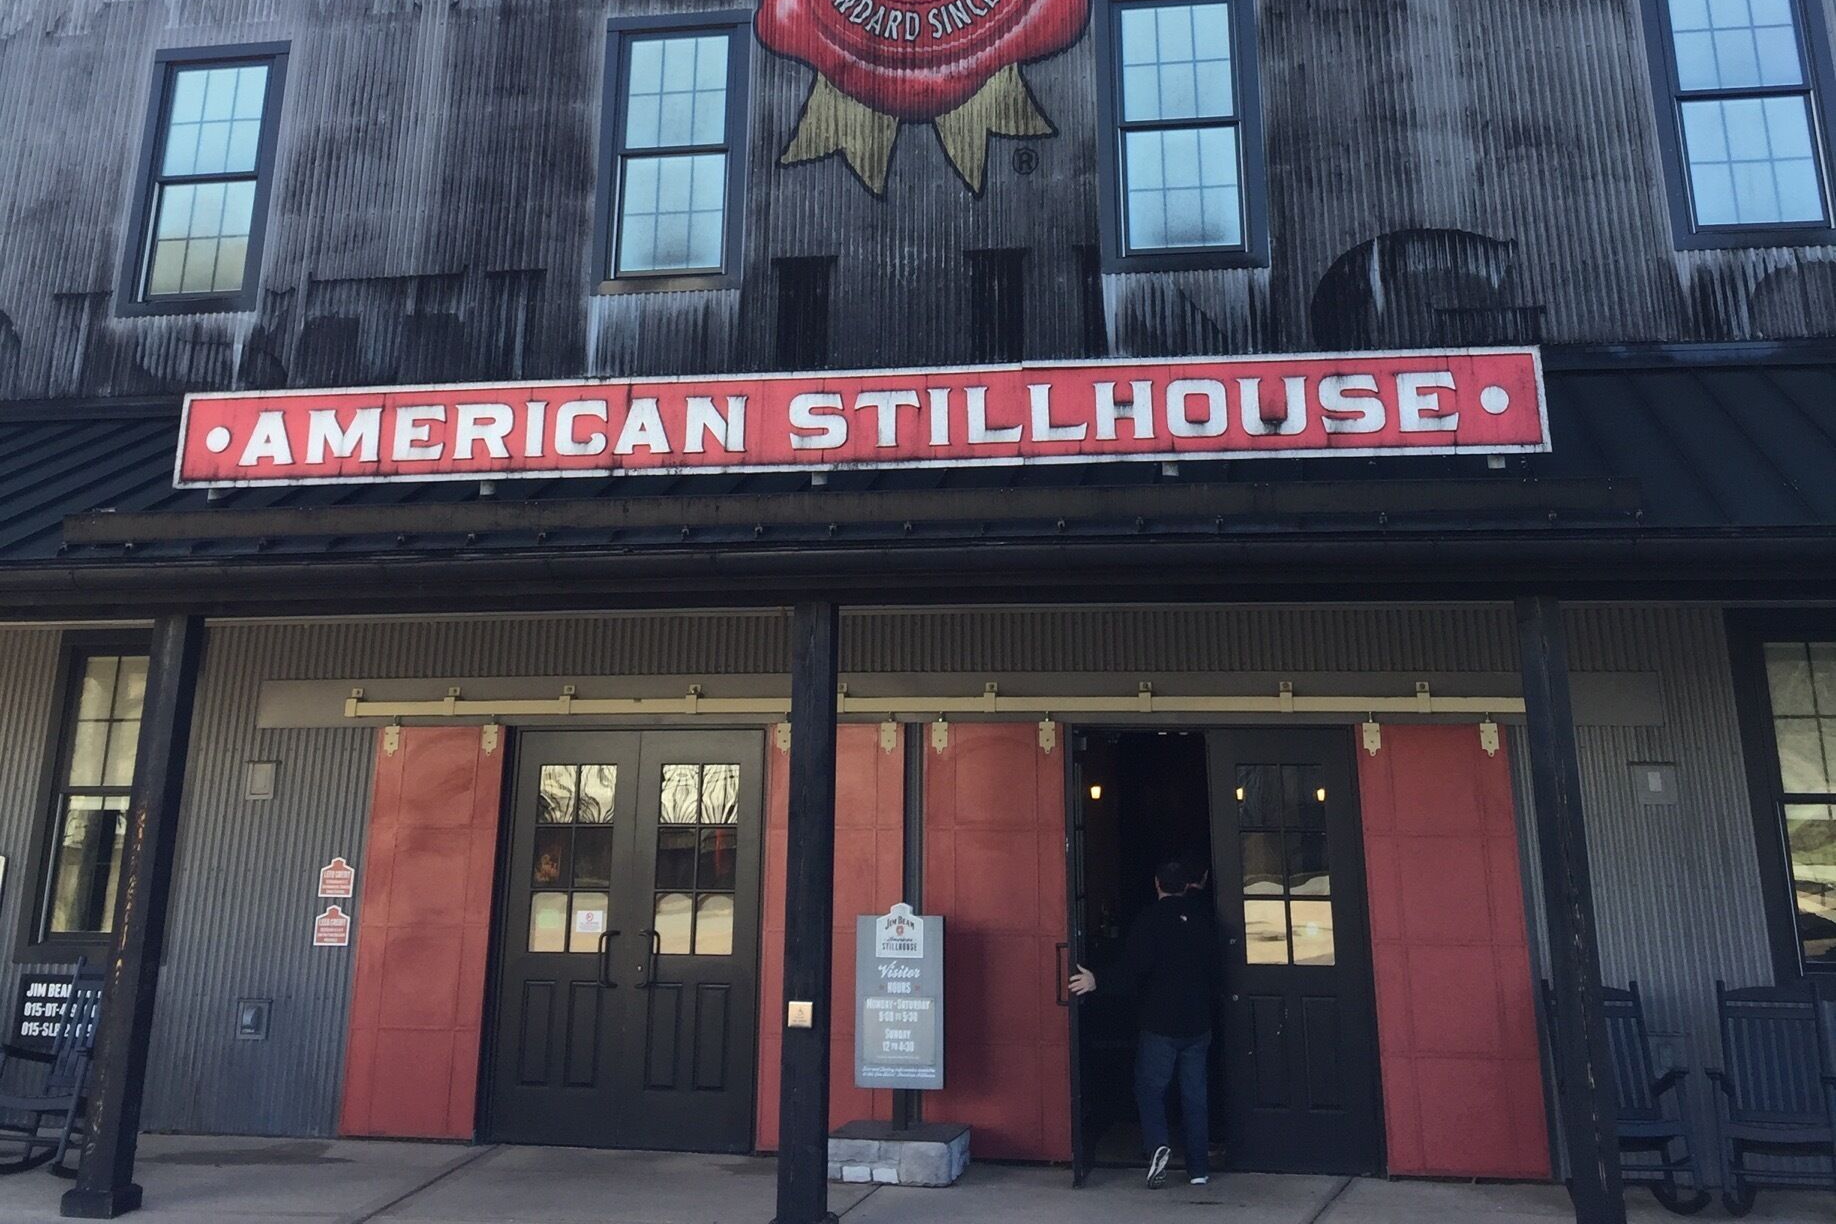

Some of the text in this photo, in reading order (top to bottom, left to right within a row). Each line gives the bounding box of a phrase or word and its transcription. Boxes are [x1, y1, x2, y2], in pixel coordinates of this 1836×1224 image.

[237, 369, 1460, 468] AMERICAN STILLHOUSE
[878, 960, 921, 979] Visitor
[26, 982, 47, 998] JIM
